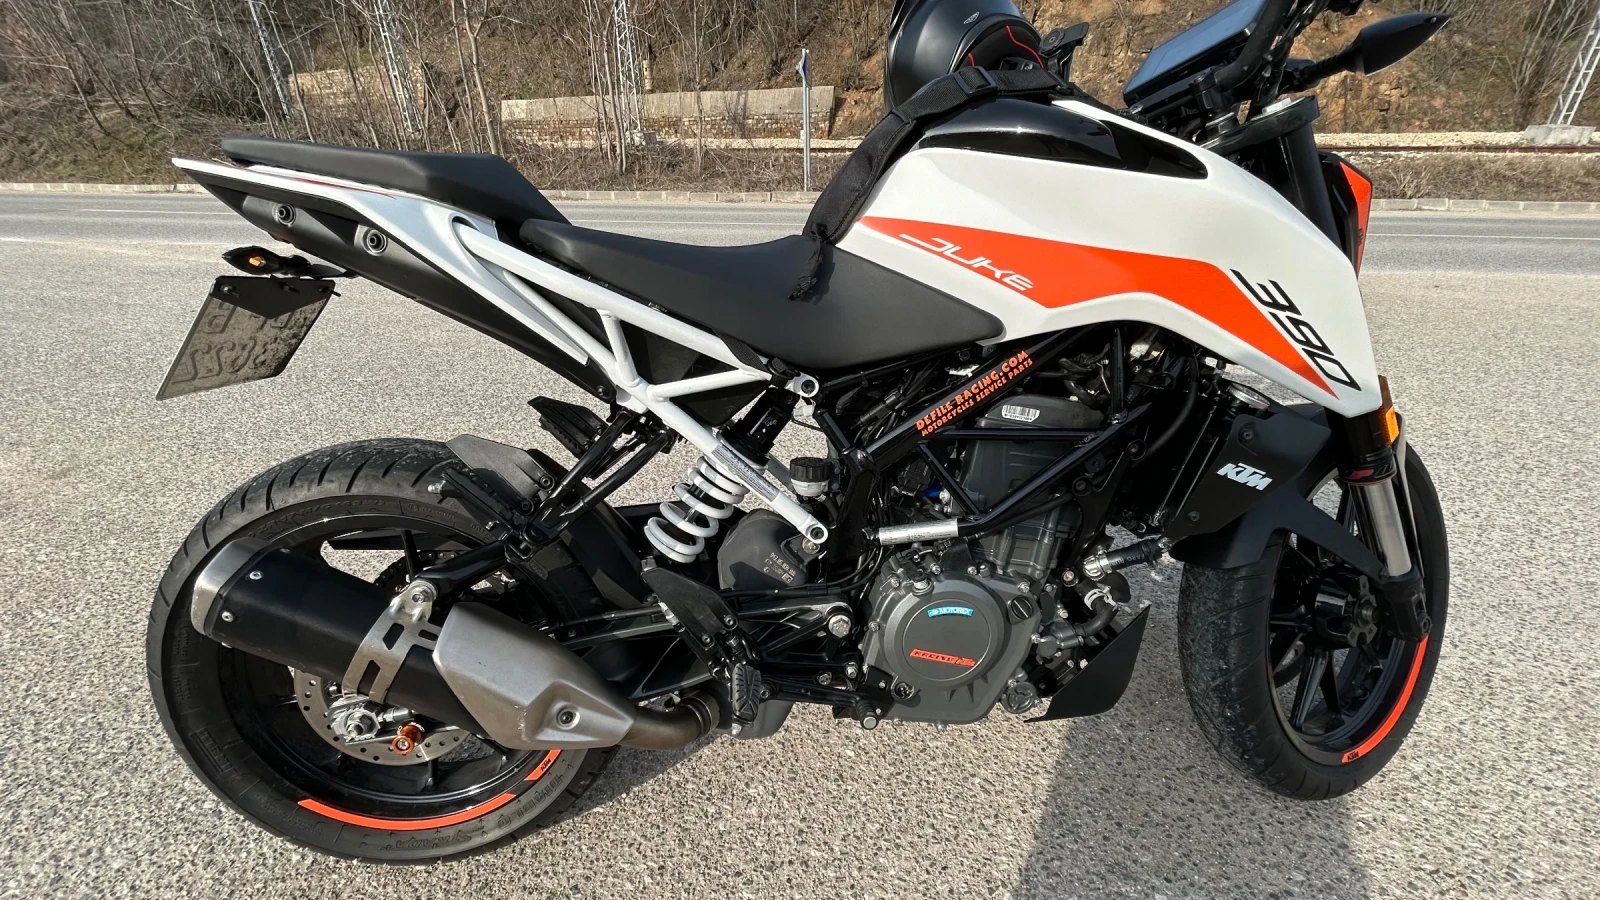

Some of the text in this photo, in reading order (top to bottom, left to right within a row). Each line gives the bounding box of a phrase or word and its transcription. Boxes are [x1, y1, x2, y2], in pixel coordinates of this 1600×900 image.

[899, 234, 1034, 291] DUKE
[1229, 268, 1362, 391] 390
[916, 350, 1029, 431] DEFILE RACING.COM
[921, 358, 1033, 437] MOTORCYCLES SERVICE PARTS
[1217, 462, 1273, 491] KTM
[939, 606, 971, 616] MOTOREX
